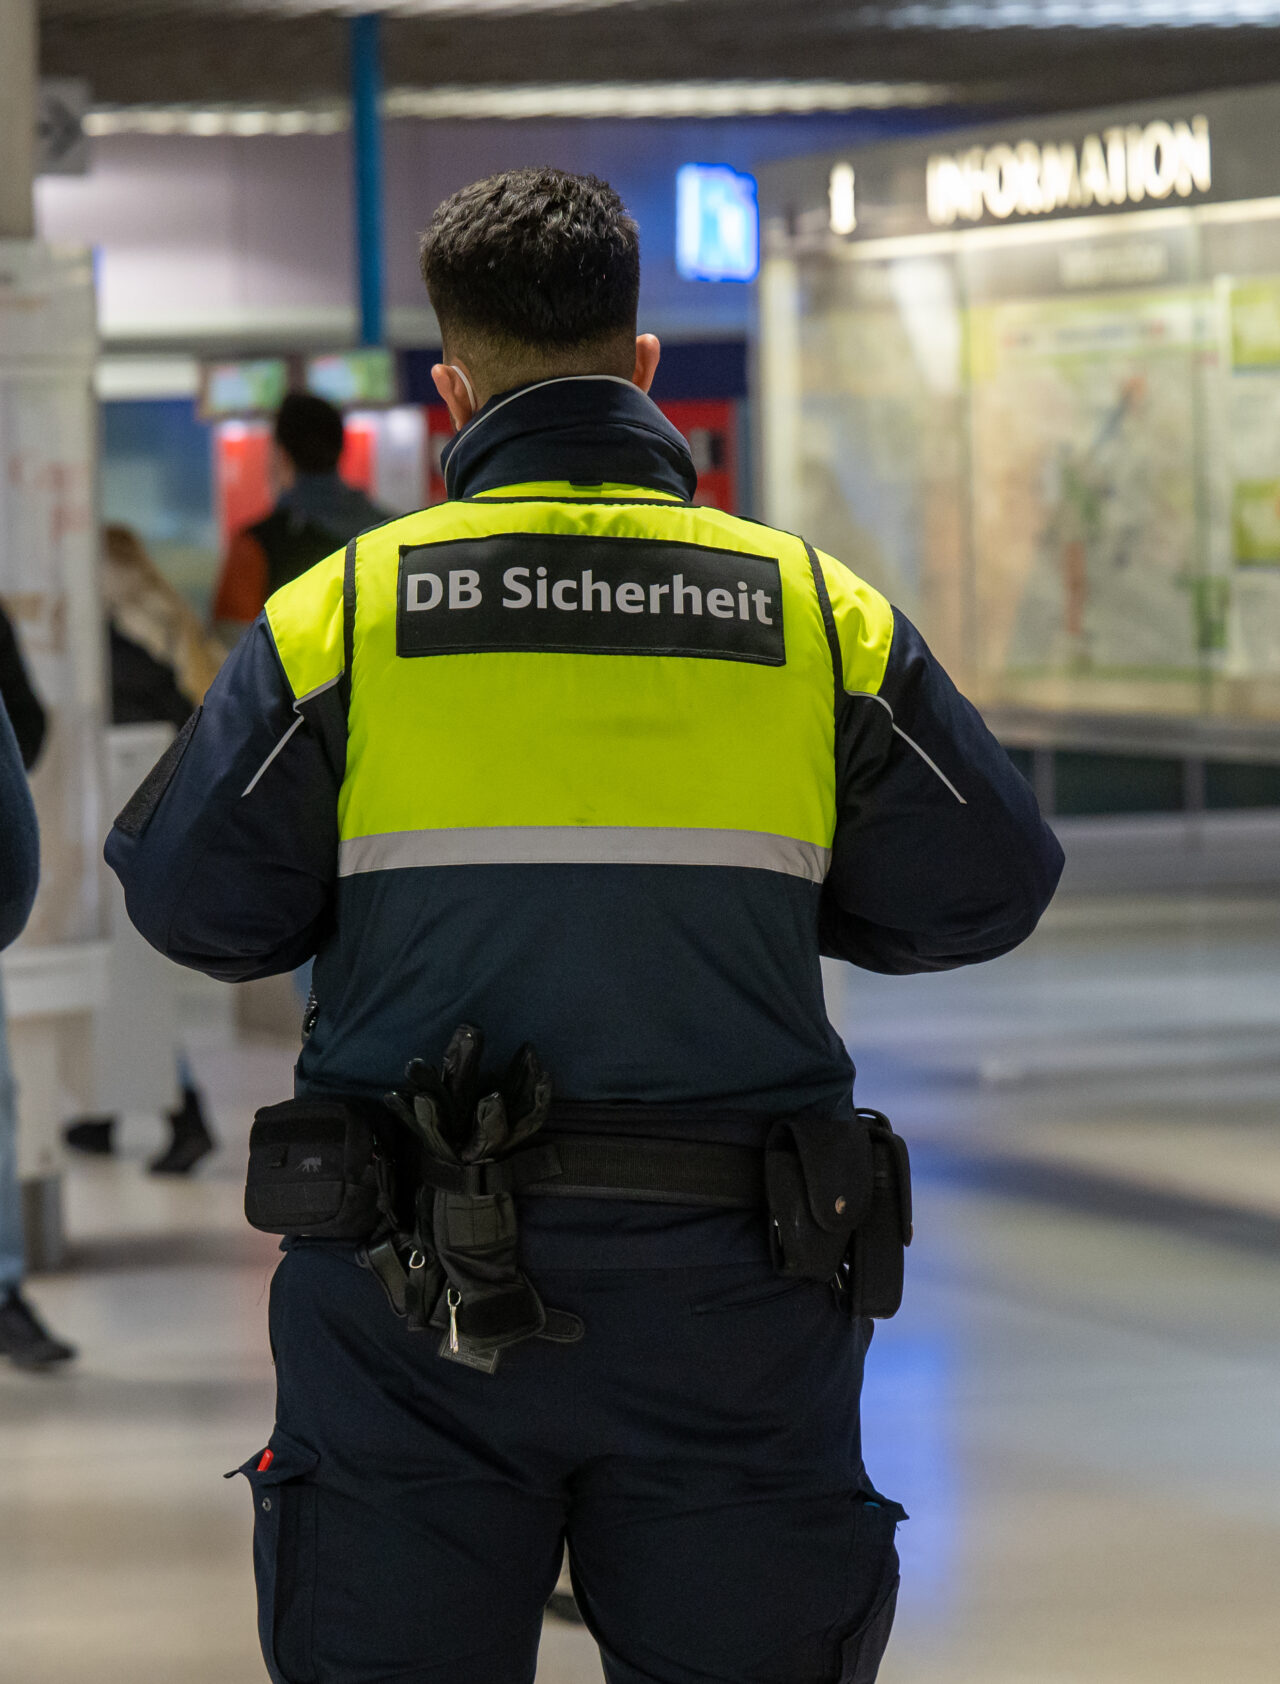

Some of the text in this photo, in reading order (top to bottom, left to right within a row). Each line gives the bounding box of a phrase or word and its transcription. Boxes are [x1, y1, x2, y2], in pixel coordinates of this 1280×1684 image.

[926, 114, 1212, 227] INFORMATION
[406, 566, 773, 625] DB Sicherheit
